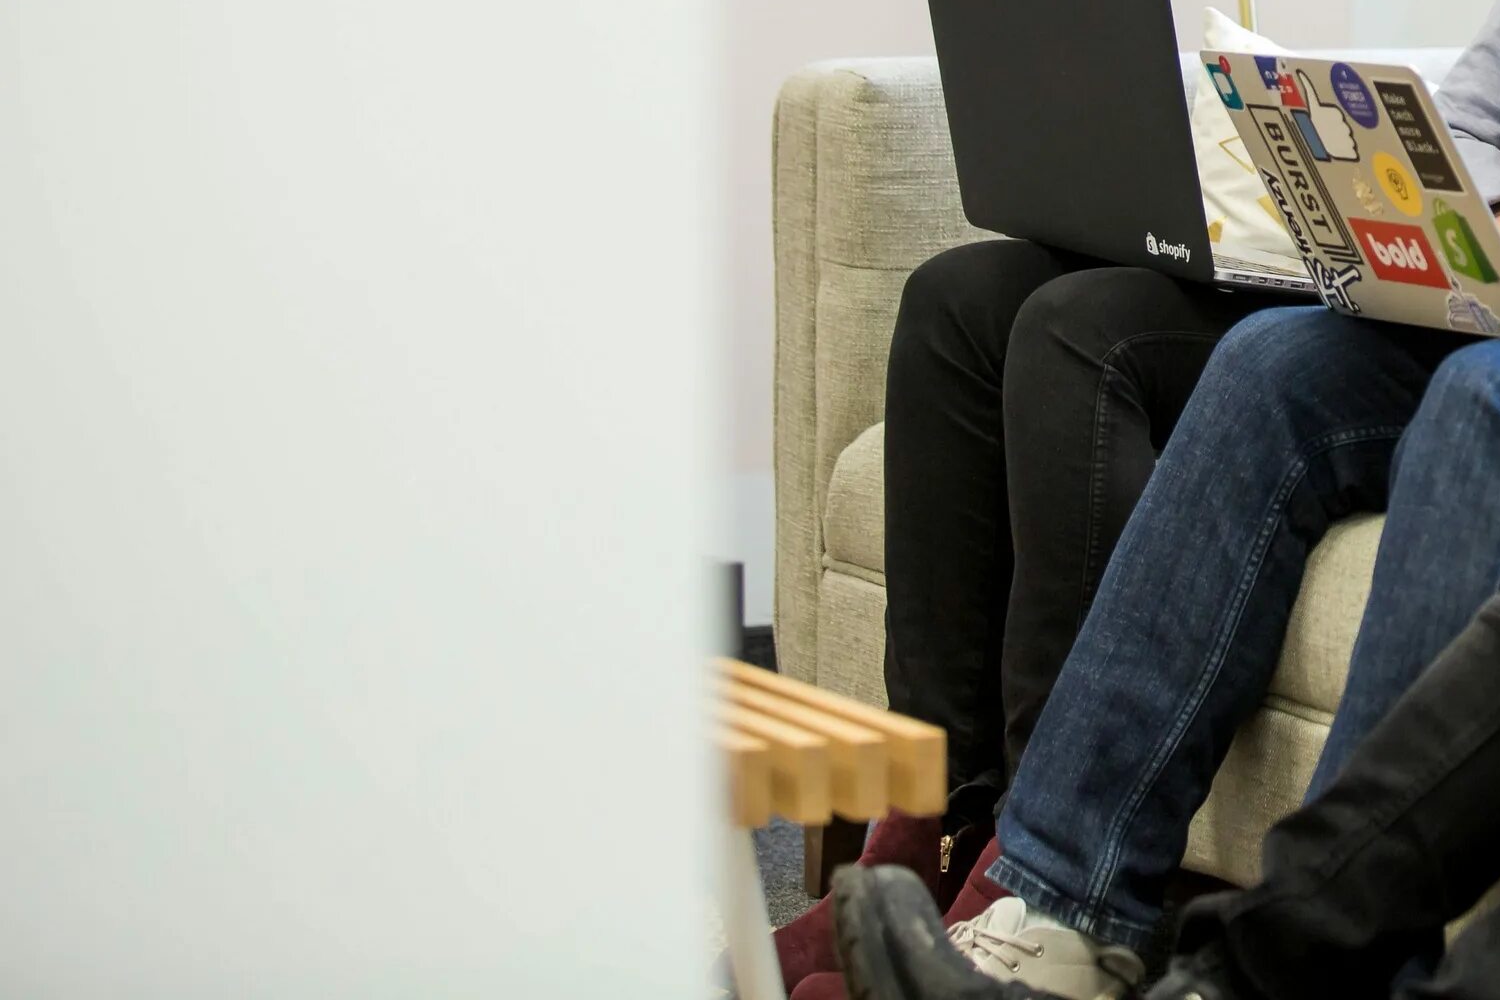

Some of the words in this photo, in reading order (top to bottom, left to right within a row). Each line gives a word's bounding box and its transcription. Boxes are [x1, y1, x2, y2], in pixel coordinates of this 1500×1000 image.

[1263, 121, 1333, 235] BURST
[1159, 239, 1191, 263] shopify
[1366, 232, 1429, 272] bold
